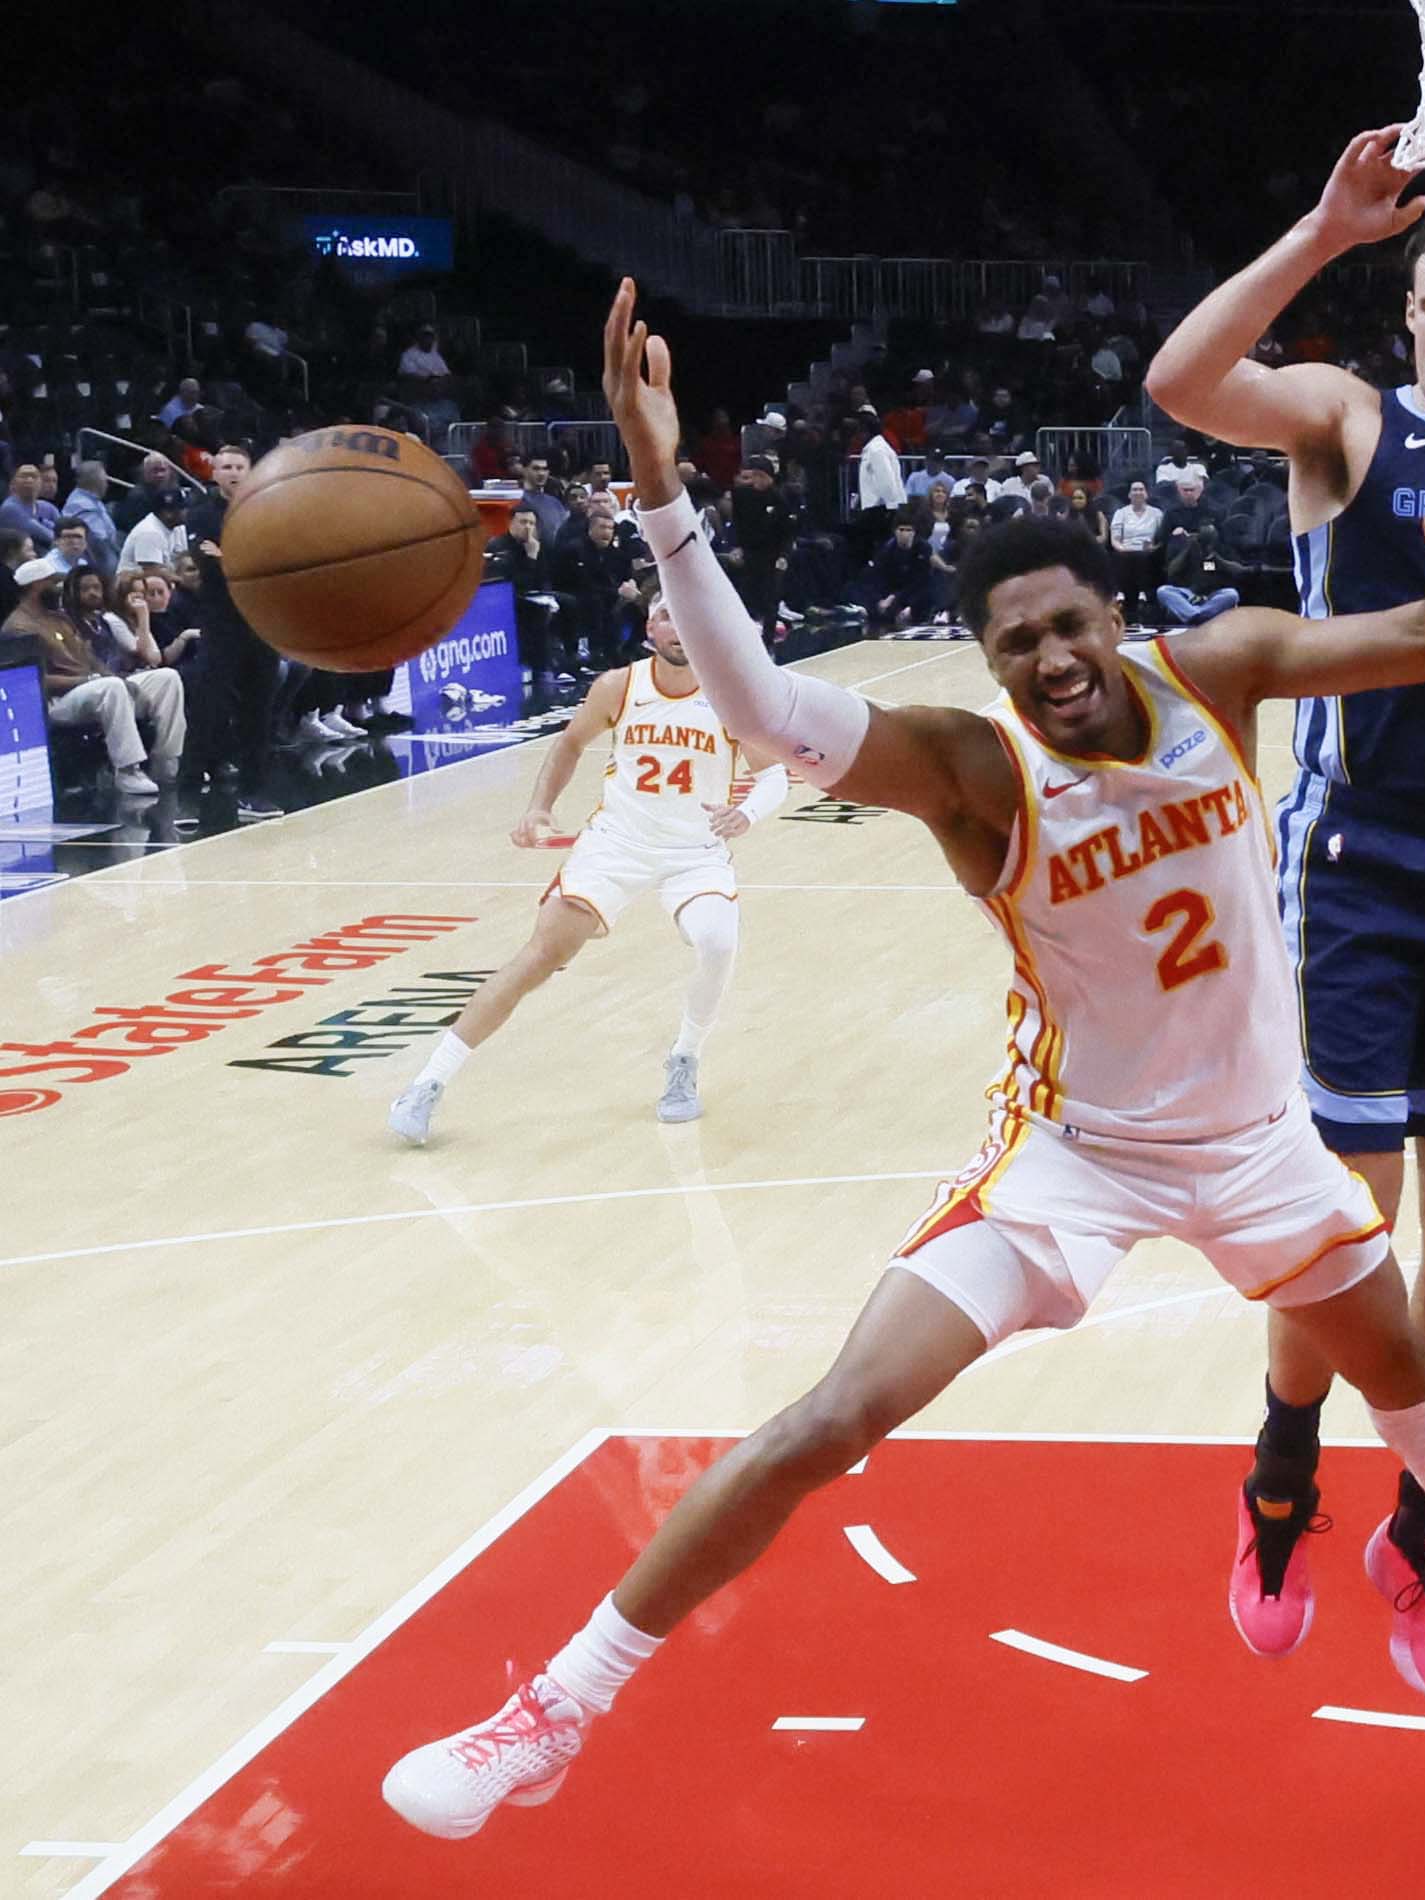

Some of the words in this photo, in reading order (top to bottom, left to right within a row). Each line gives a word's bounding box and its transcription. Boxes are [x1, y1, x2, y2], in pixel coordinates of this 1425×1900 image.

[437, 630, 507, 678] gng.com
[623, 723, 717, 755] ATLANTA
[1159, 729, 1208, 770] paze
[635, 754, 694, 795] 24
[1048, 780, 1248, 906] ATLANTA
[1142, 887, 1229, 993] 2
